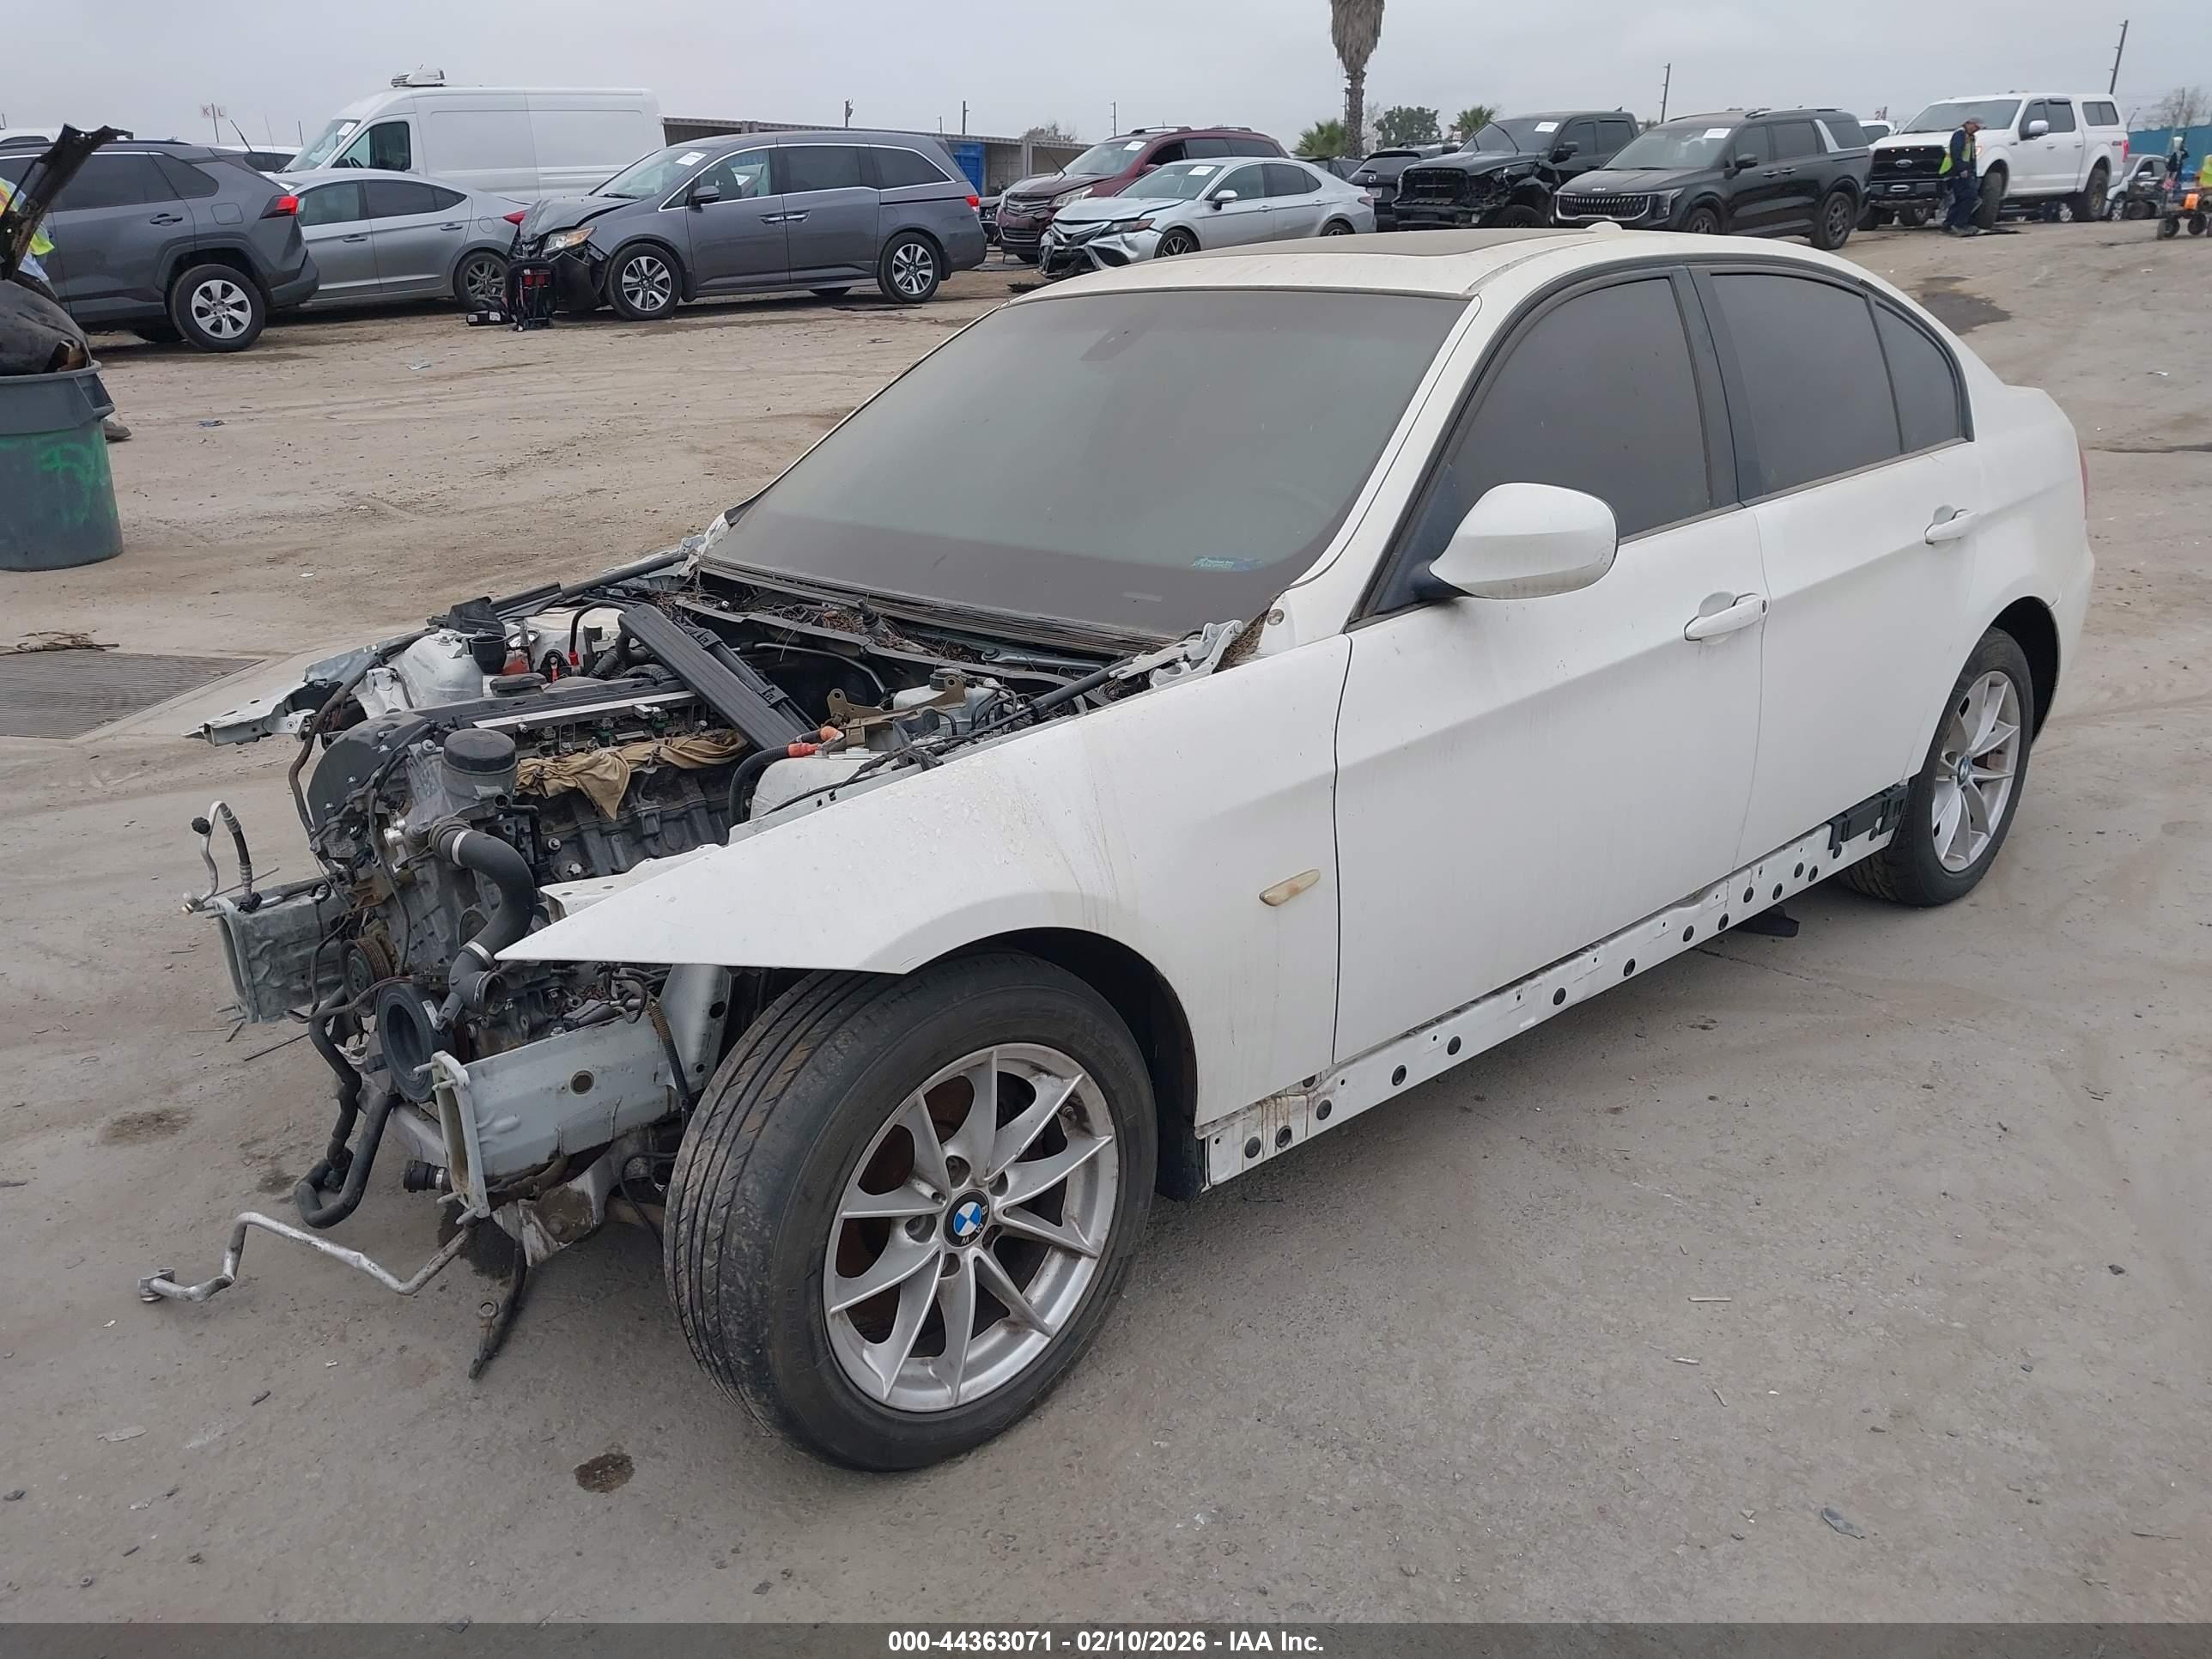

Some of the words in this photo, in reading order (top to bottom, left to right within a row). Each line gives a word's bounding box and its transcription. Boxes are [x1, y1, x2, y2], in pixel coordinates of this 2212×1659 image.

[202, 106, 210, 116] K
[217, 107, 224, 117] L
[961, 1205, 988, 1245] BMW
